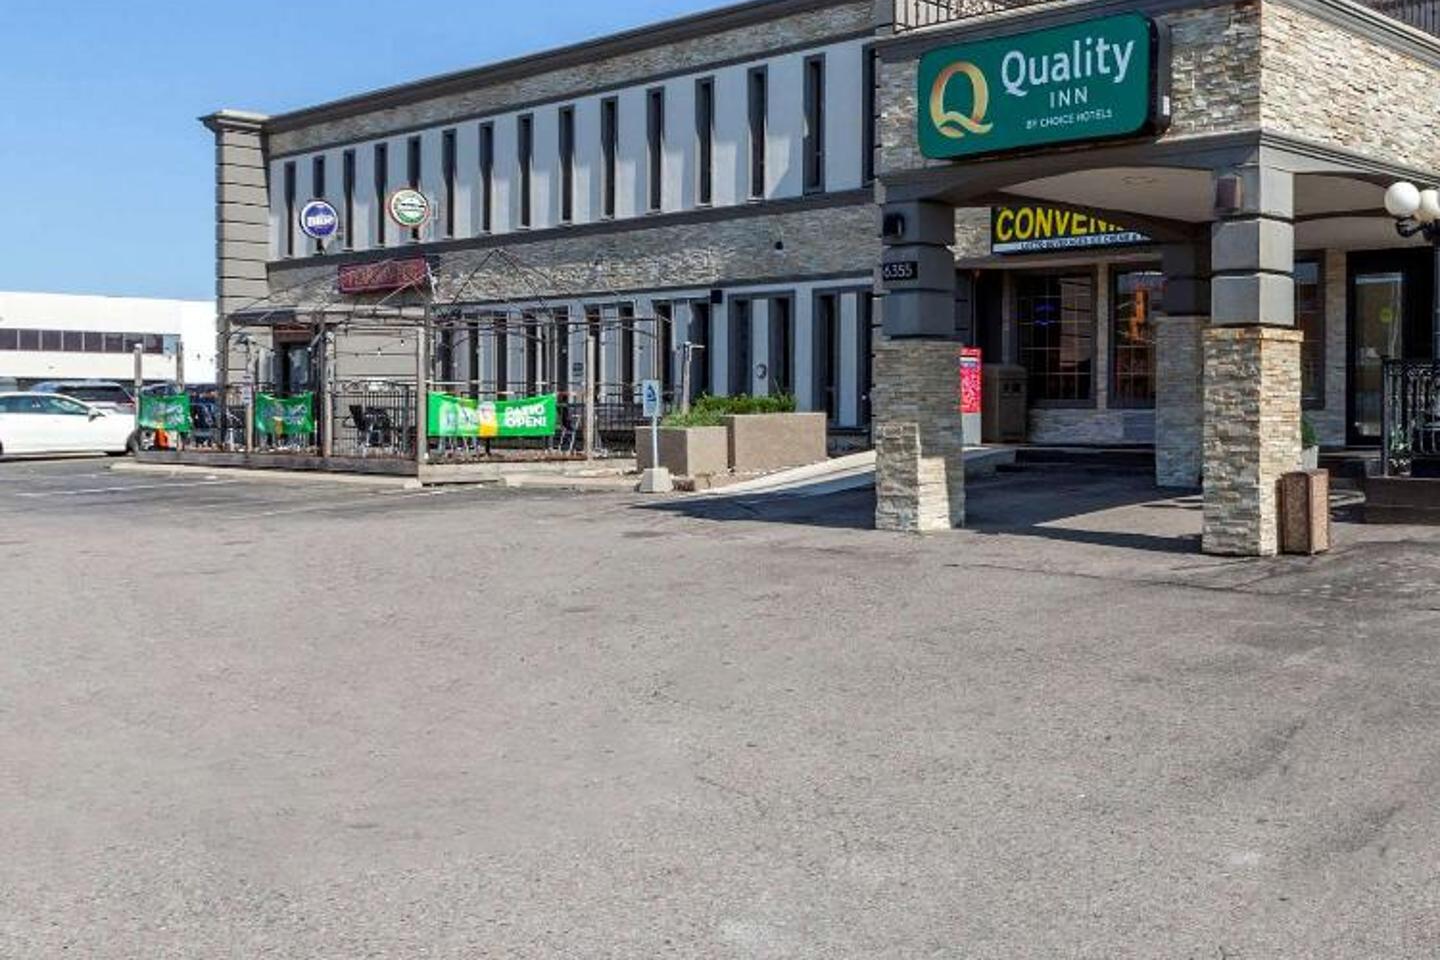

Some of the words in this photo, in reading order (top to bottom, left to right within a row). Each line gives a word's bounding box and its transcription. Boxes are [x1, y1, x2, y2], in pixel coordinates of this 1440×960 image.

[1001, 37, 1135, 97] Quality
[930, 61, 993, 138] Q
[1050, 86, 1088, 108] INN
[1040, 114, 1074, 128] CHOICE
[1077, 108, 1113, 123] HOTELS
[996, 206, 1124, 241] CONVEN
[882, 263, 913, 279] 6355
